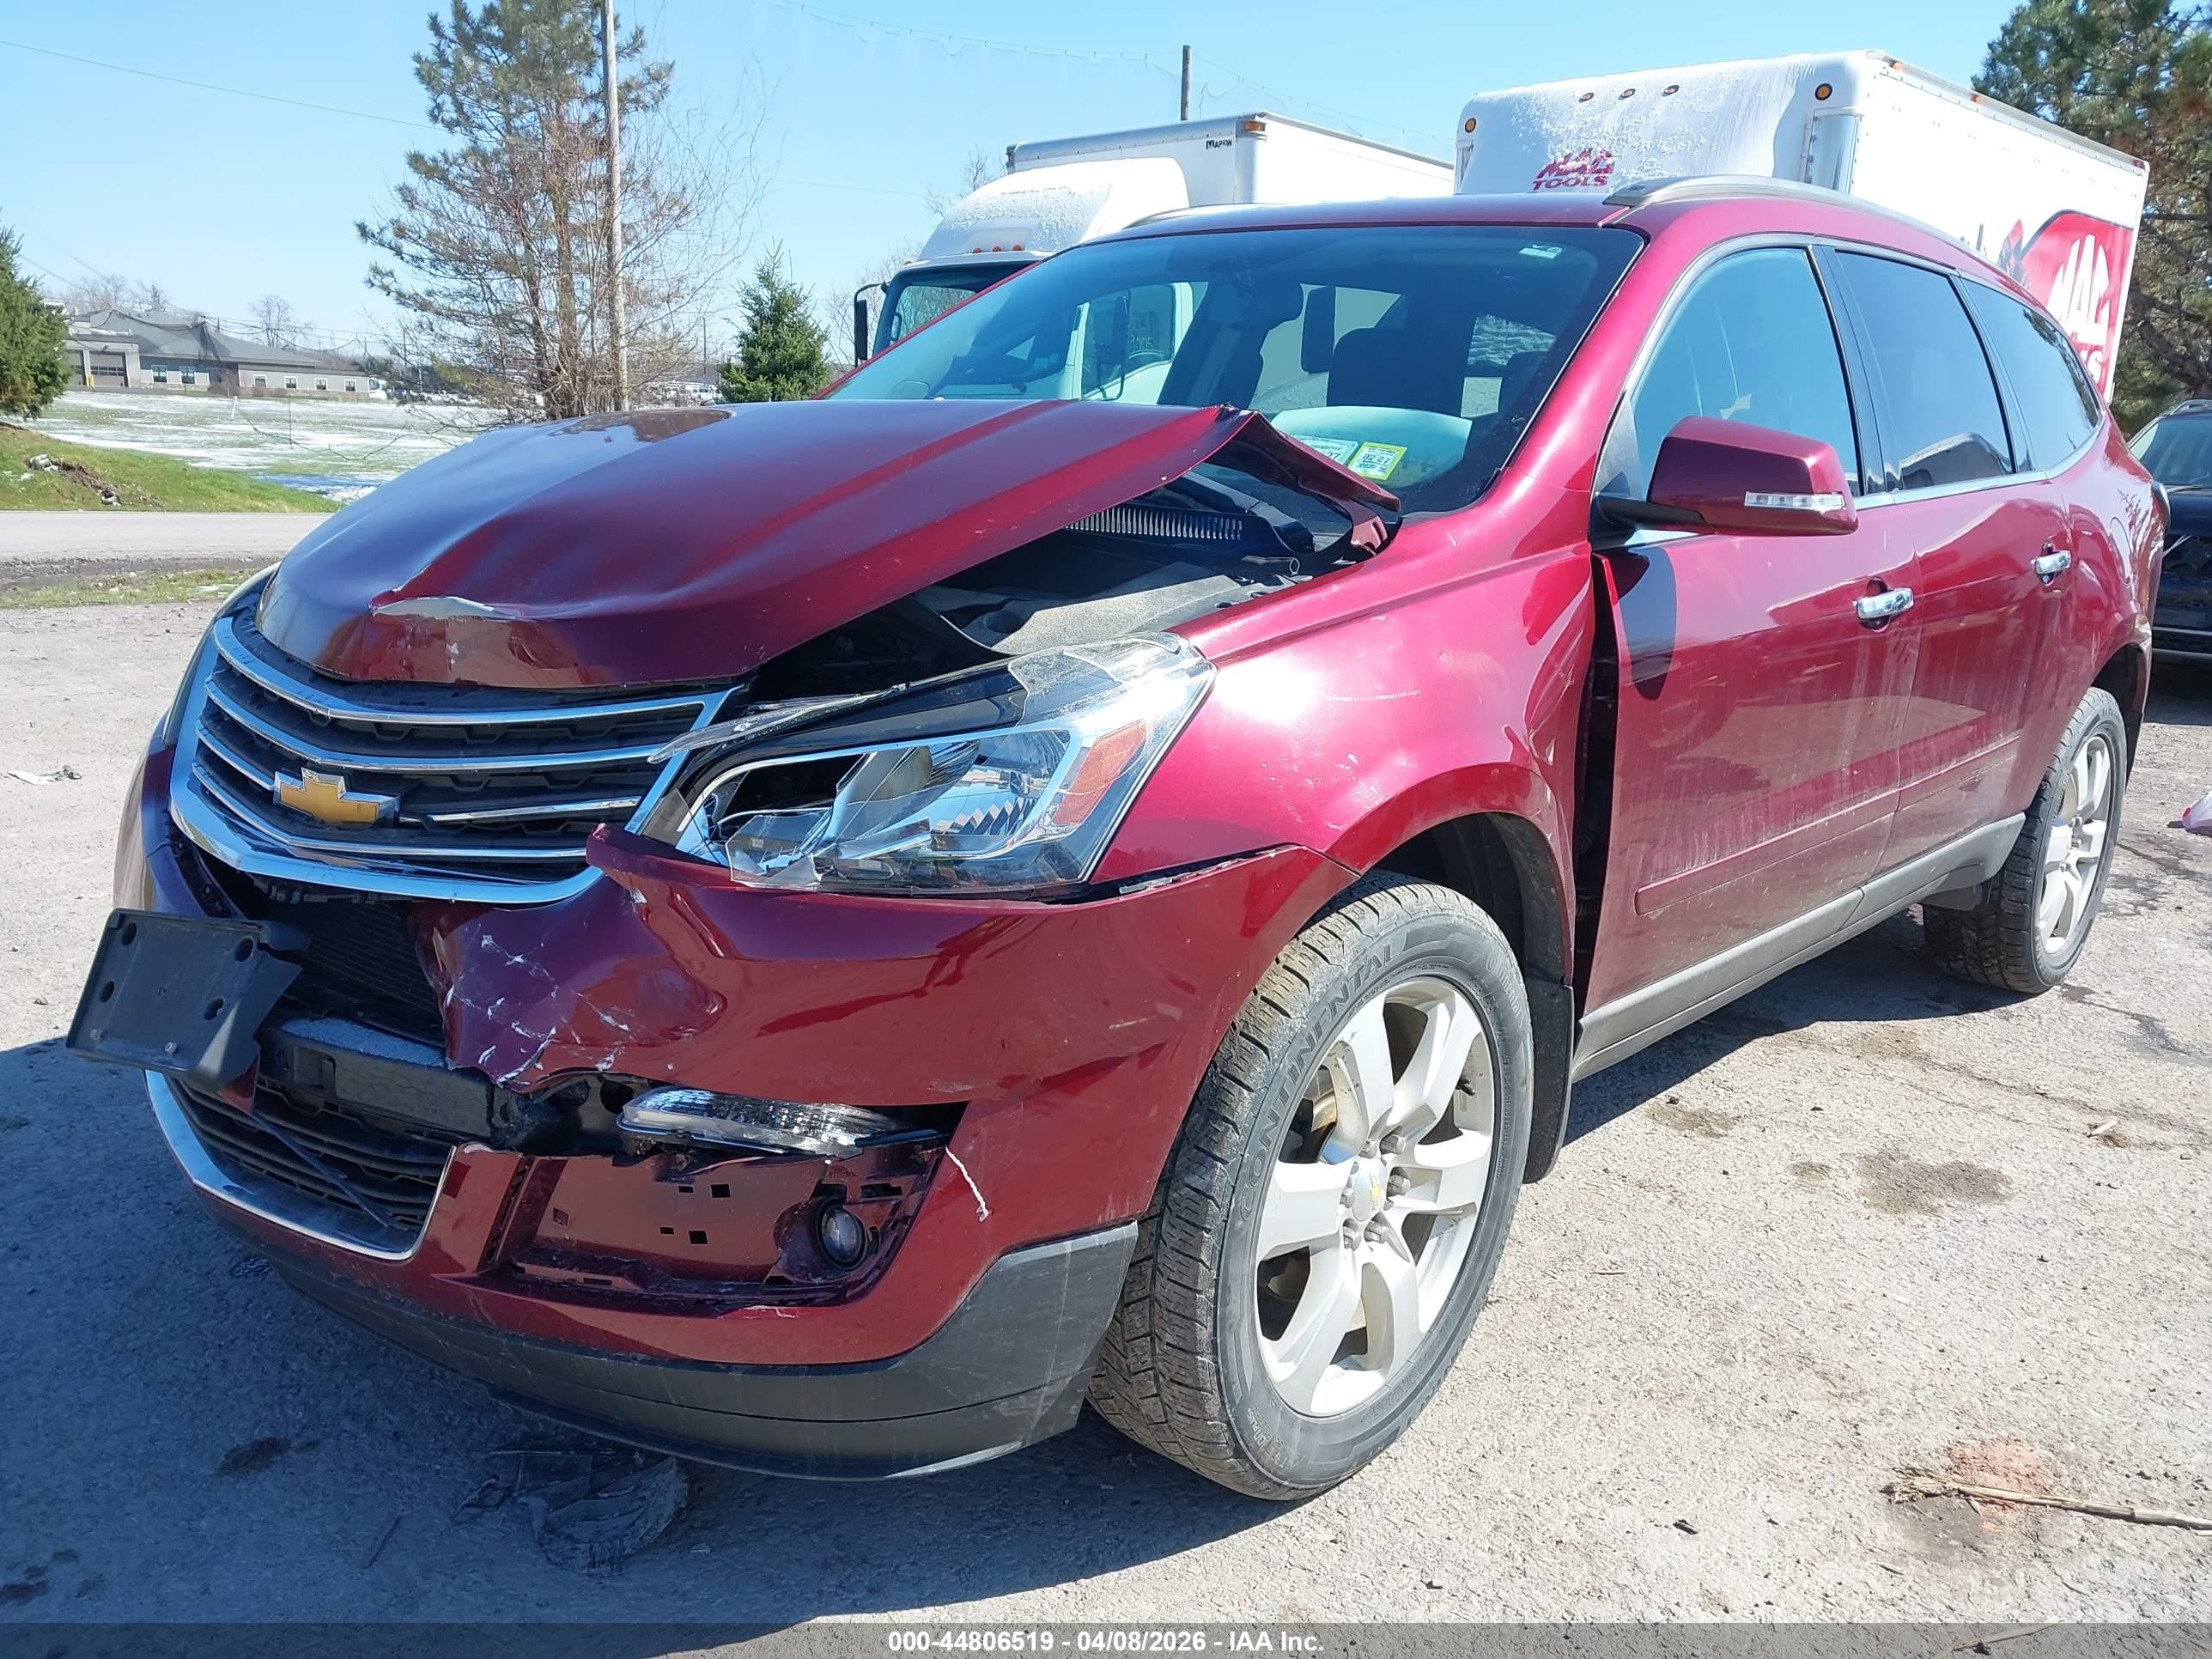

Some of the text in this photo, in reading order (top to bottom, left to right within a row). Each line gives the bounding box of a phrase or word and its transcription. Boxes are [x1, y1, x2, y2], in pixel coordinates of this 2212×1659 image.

[1206, 139, 1232, 149] MARION
[1532, 175, 1609, 191] TOOLS
[1363, 453, 1391, 465] 02-27
[1240, 943, 1399, 1221] CONTINENTAL
